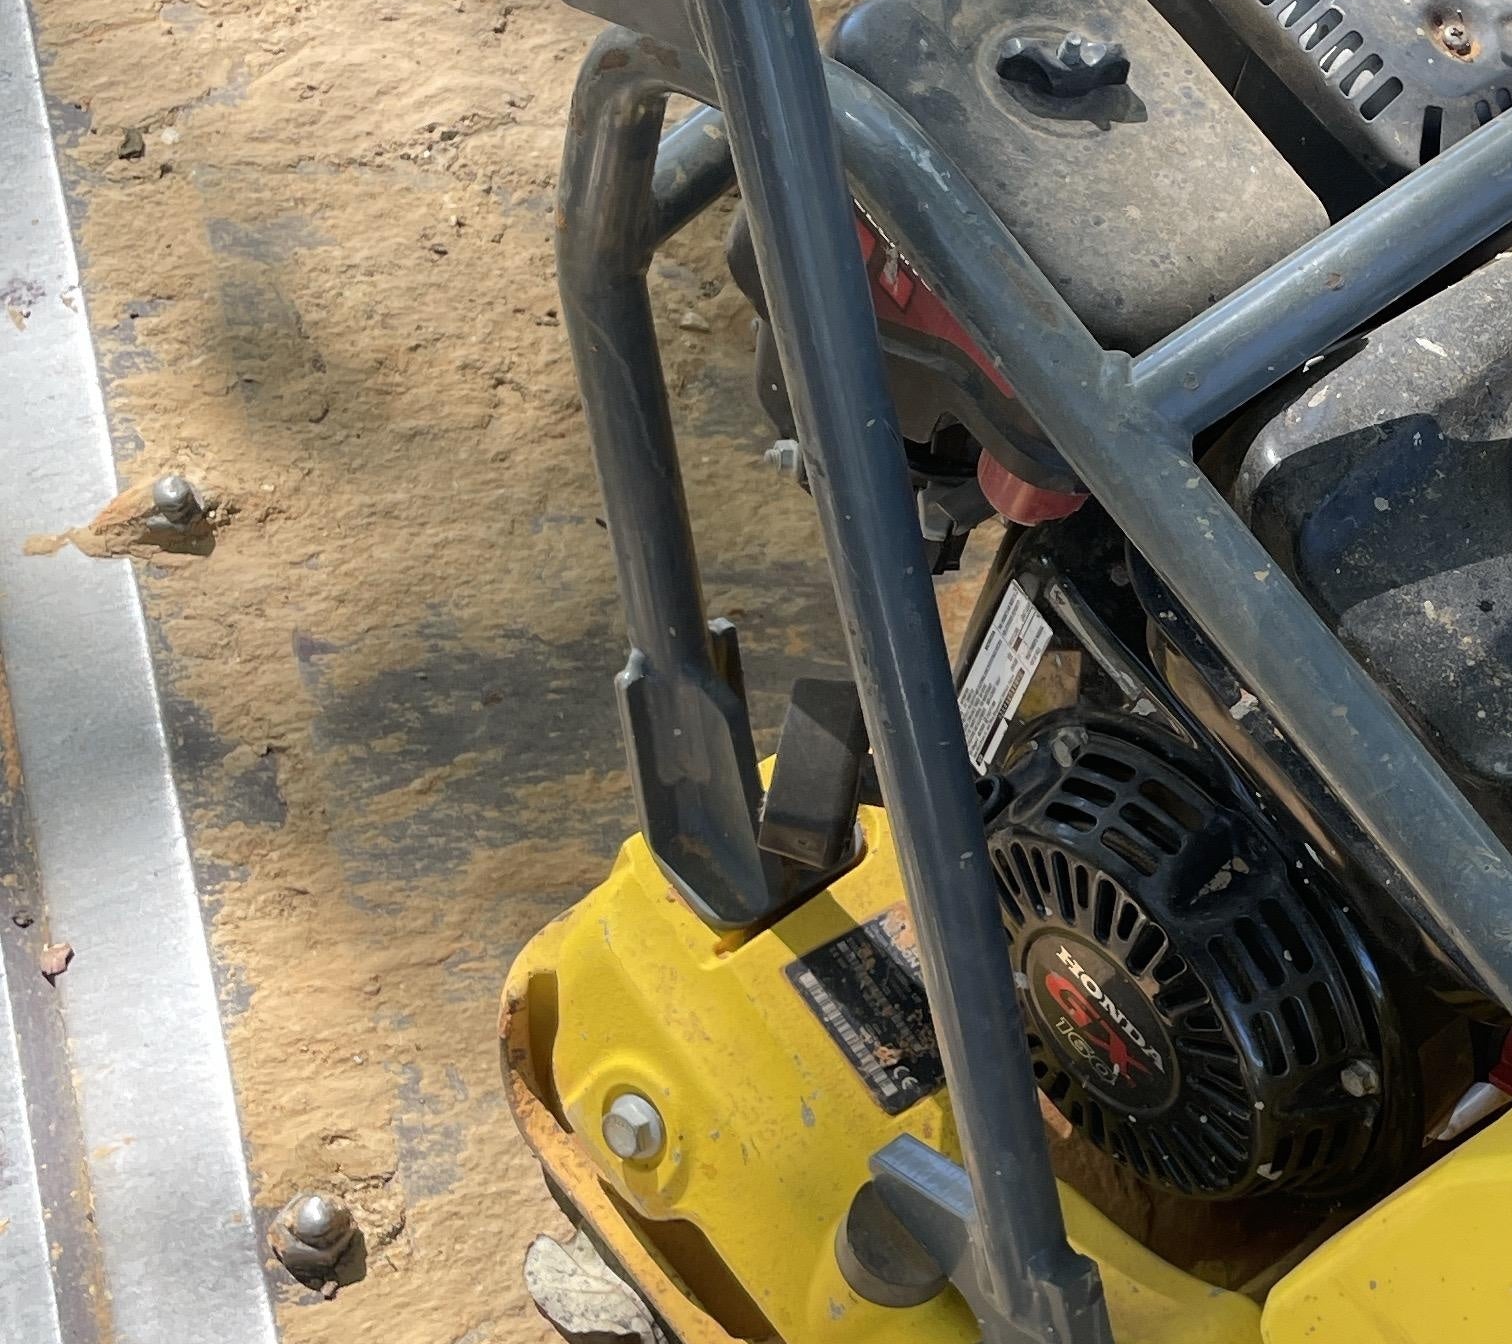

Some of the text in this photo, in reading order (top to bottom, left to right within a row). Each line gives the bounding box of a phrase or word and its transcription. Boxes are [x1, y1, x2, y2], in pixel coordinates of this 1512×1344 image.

[1045, 970, 1153, 1089] GX
[1055, 945, 1166, 1075] HONDA
[1055, 1016, 1119, 1087] 160
